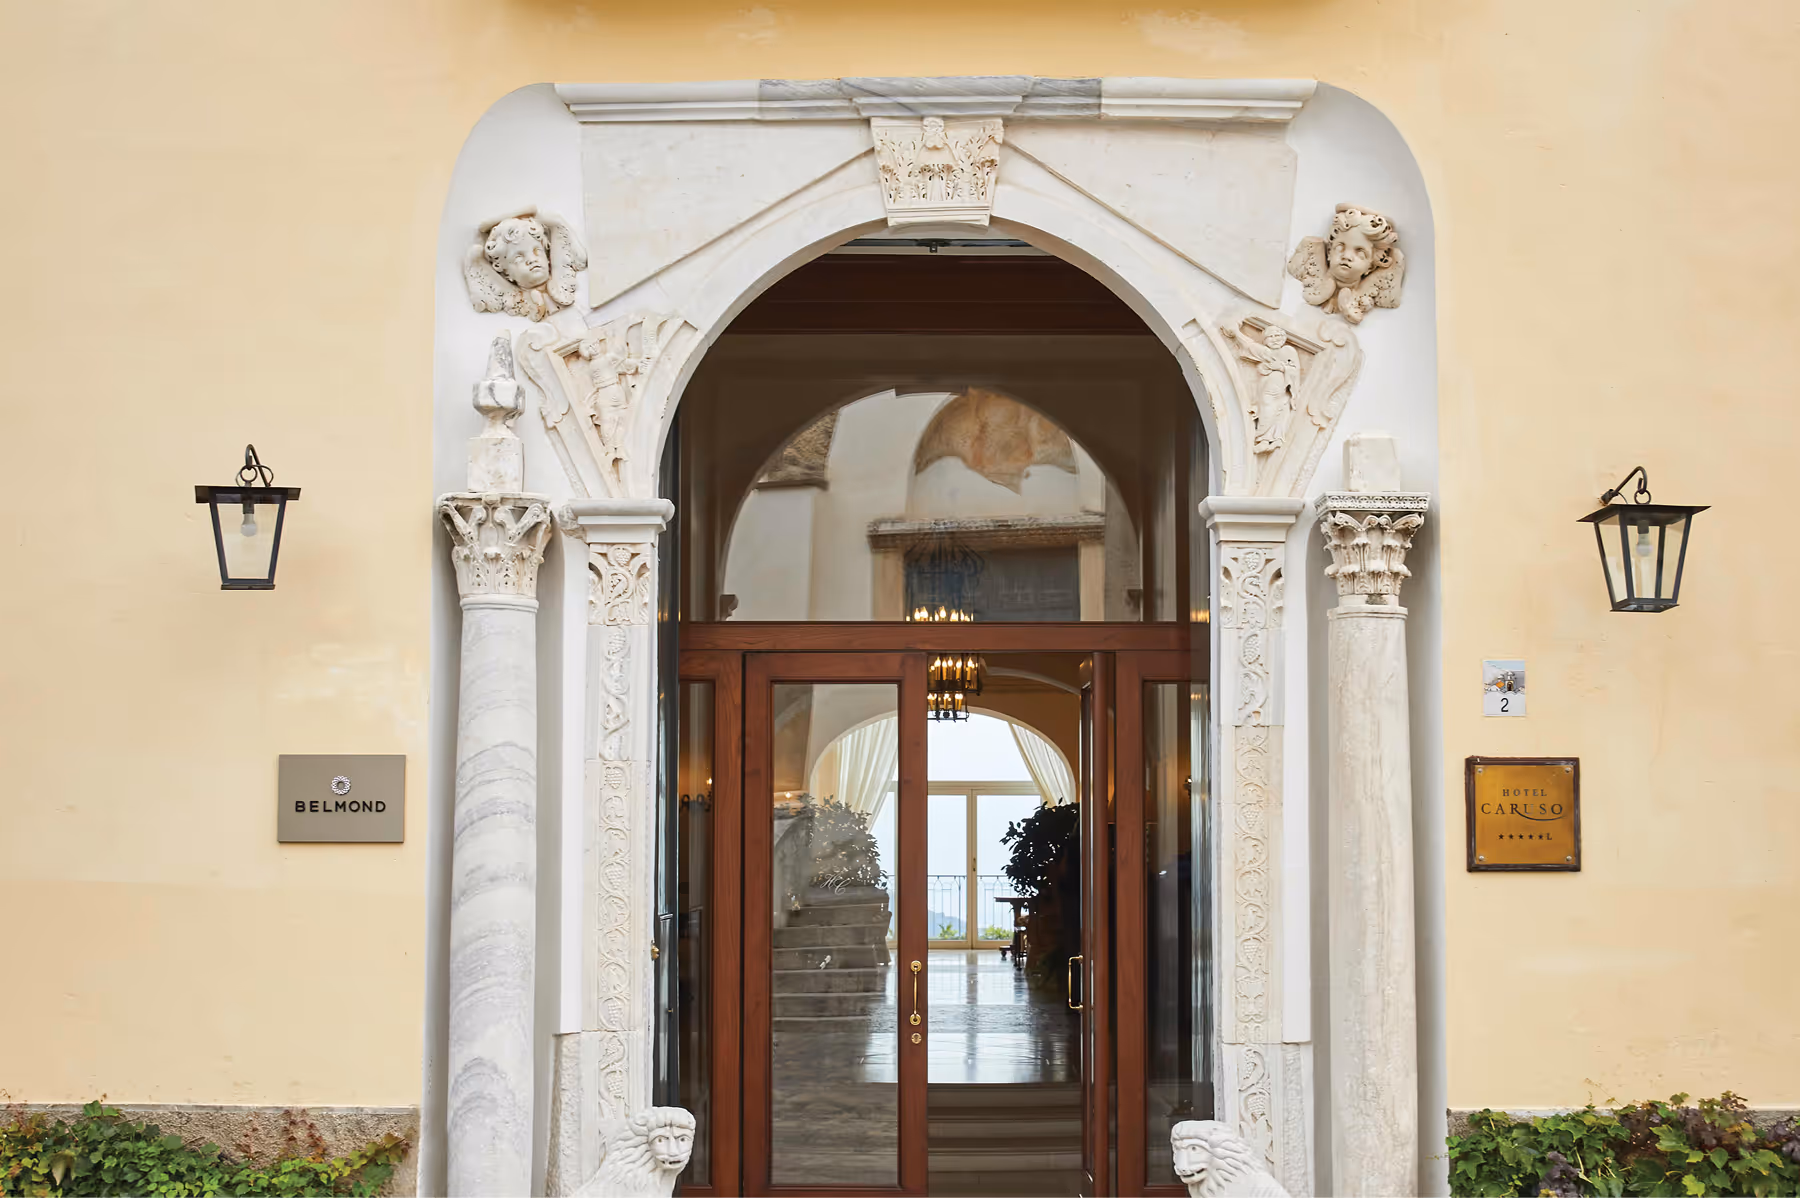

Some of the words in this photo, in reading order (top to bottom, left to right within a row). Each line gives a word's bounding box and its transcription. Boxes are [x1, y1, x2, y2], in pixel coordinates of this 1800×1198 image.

[1500, 697, 1509, 713] 2
[1502, 788, 1548, 797] HOTEL
[294, 800, 386, 813] BELMOND
[1481, 803, 1565, 820] CARUSO
